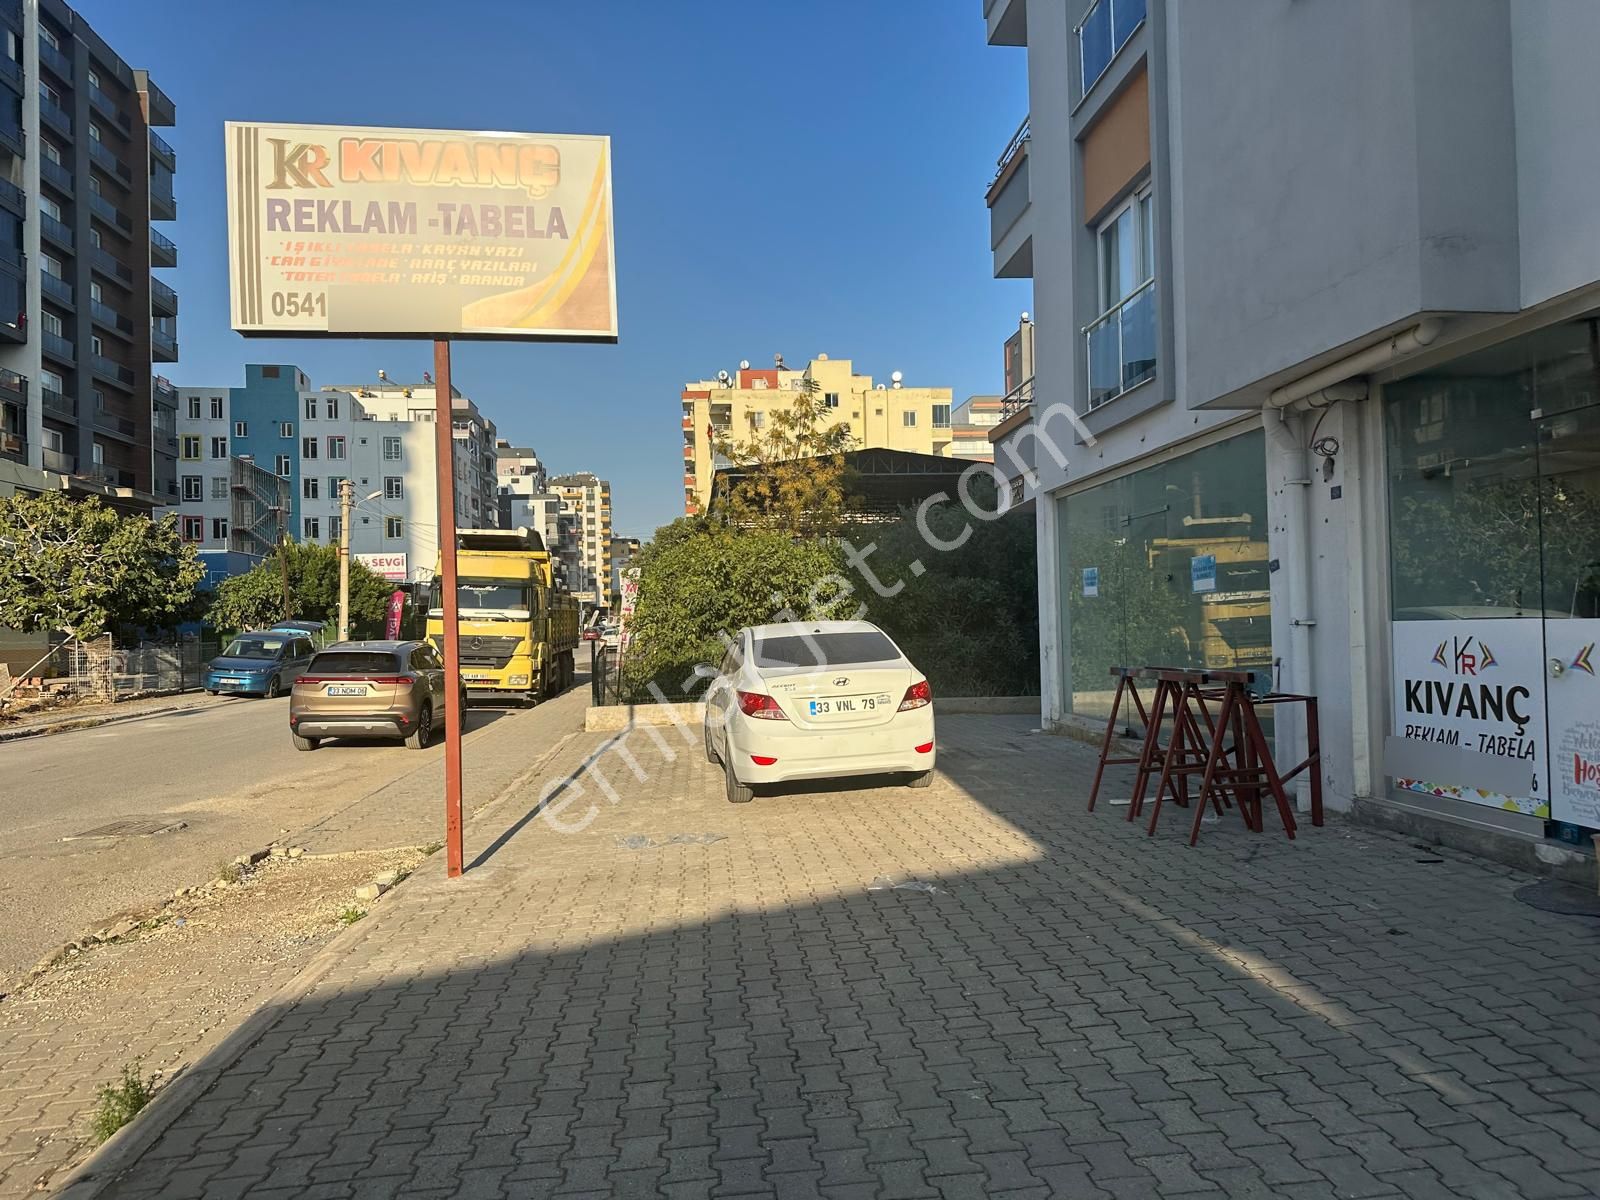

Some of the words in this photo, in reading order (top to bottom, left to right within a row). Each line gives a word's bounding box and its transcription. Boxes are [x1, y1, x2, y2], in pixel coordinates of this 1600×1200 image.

[339, 137, 561, 199] KIVANÇ
[266, 198, 417, 235] REKLAM
[422, 243, 481, 256] KAYAN
[484, 246, 524, 257] YAZI
[410, 258, 457, 273] ARAÇ
[460, 260, 538, 273] YAZILARI
[271, 291, 327, 317] 0541
[371, 555, 404, 567] SEVGİ
[816, 702, 830, 713] 33
[836, 700, 856, 712] VNL
[861, 698, 875, 710] 79
[1405, 679, 1530, 736] KIVANÇ
[1478, 733, 1536, 761] TABELA
